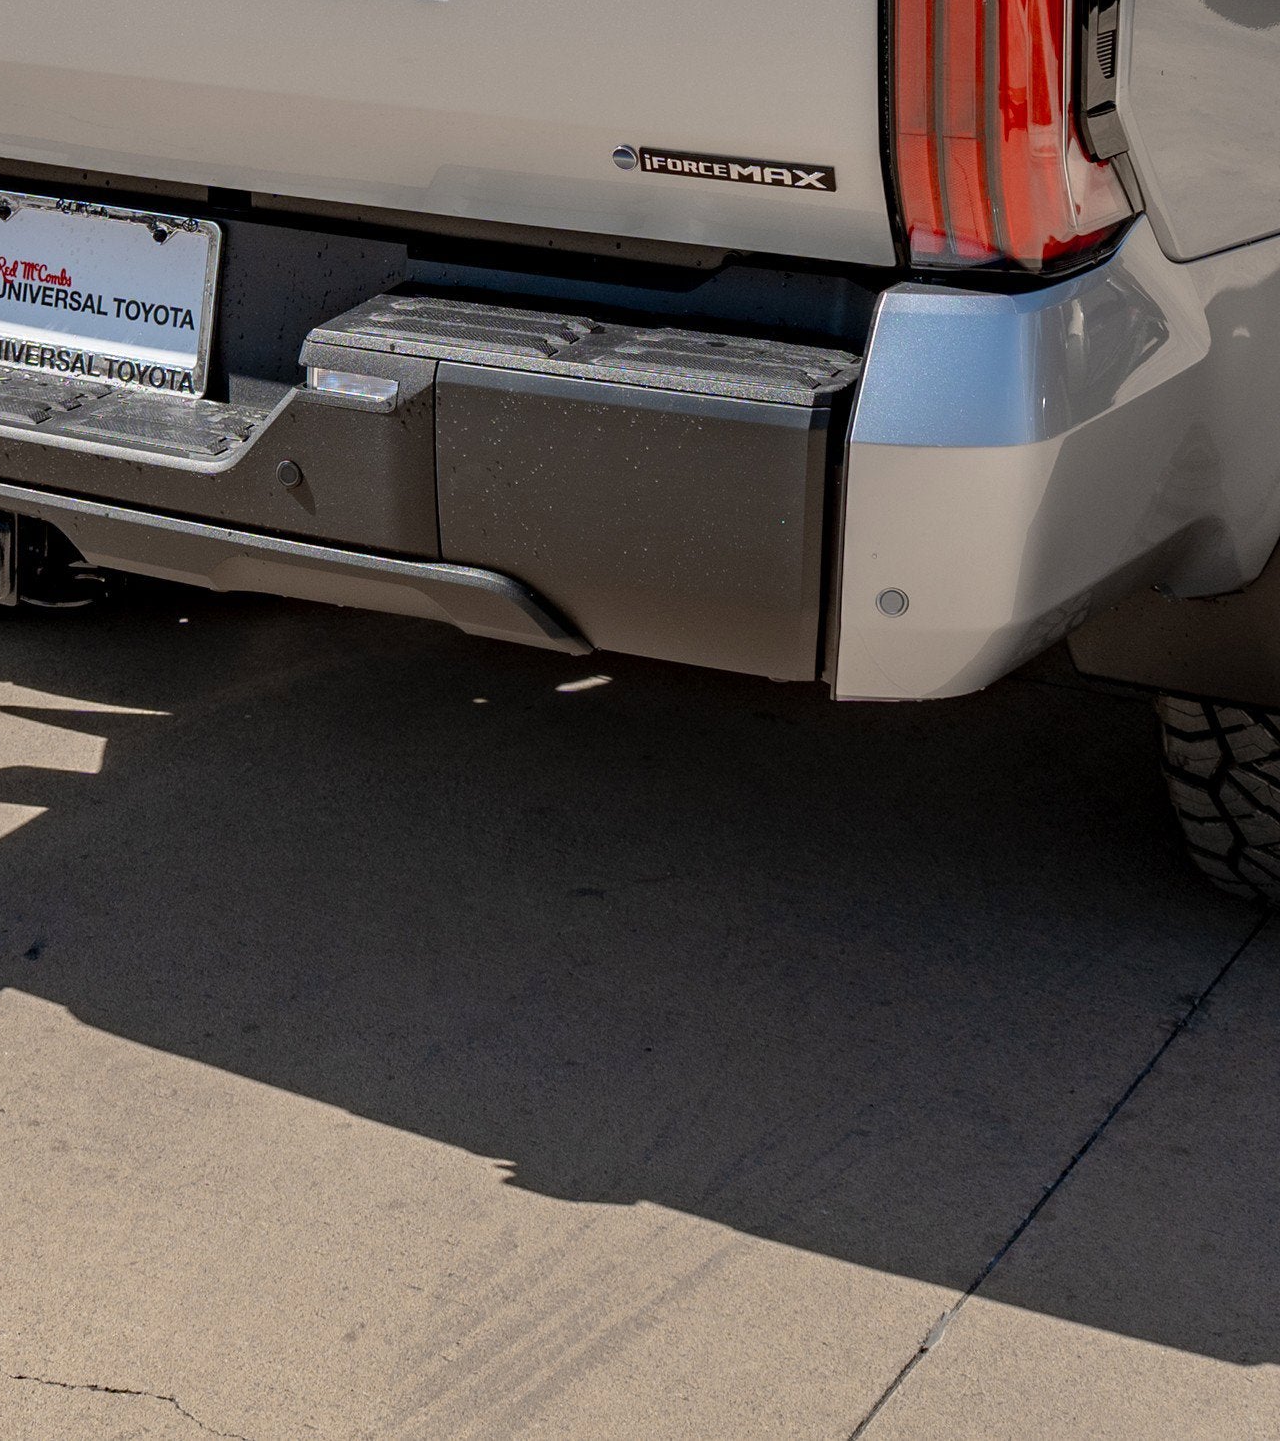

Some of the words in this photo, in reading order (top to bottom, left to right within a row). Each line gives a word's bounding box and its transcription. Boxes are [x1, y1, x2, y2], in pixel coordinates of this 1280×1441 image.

[21, 260, 72, 288] McCombs
[113, 297, 195, 331] TOYOTA
[104, 358, 196, 395] TOYOTA
